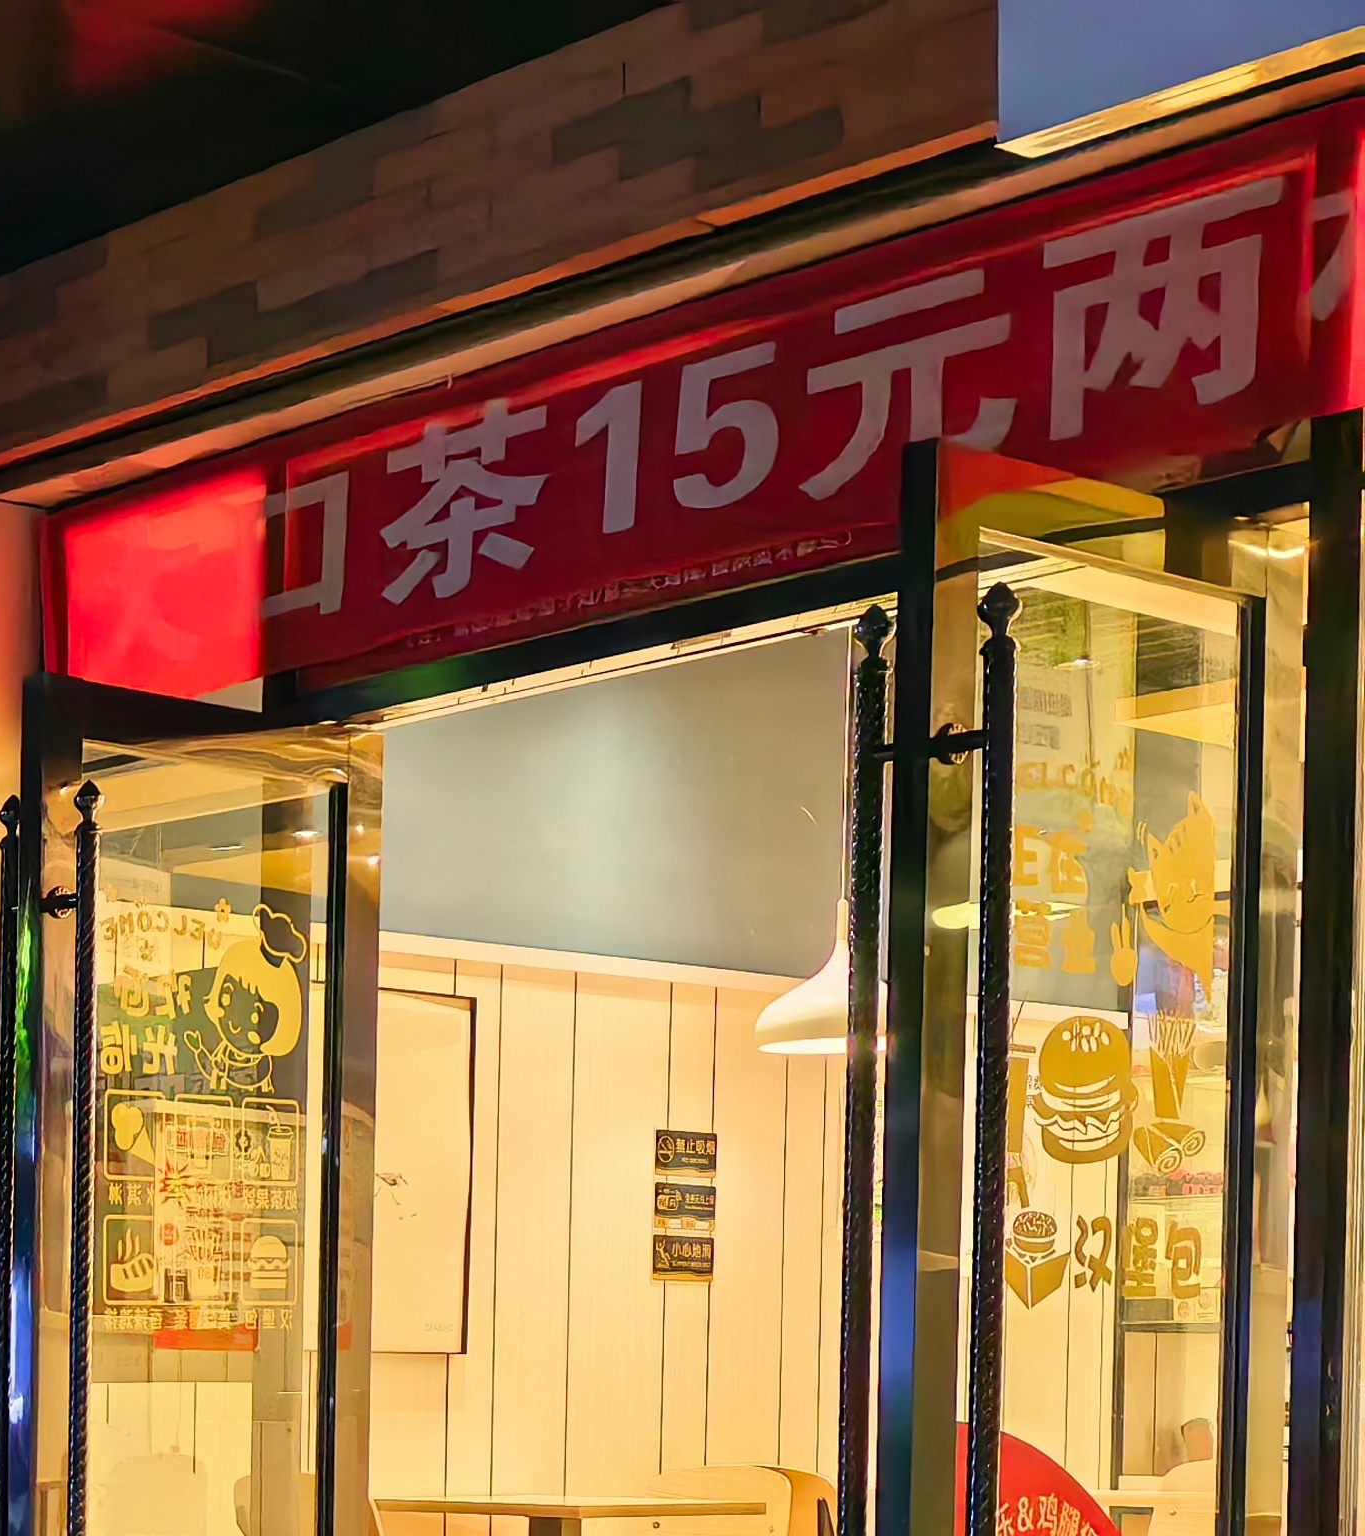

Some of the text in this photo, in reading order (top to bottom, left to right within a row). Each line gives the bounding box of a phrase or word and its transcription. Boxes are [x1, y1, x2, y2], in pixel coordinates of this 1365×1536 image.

[263, 176, 1353, 616] 口茶15元两
[1074, 1213, 1202, 1300] 汉堡包
